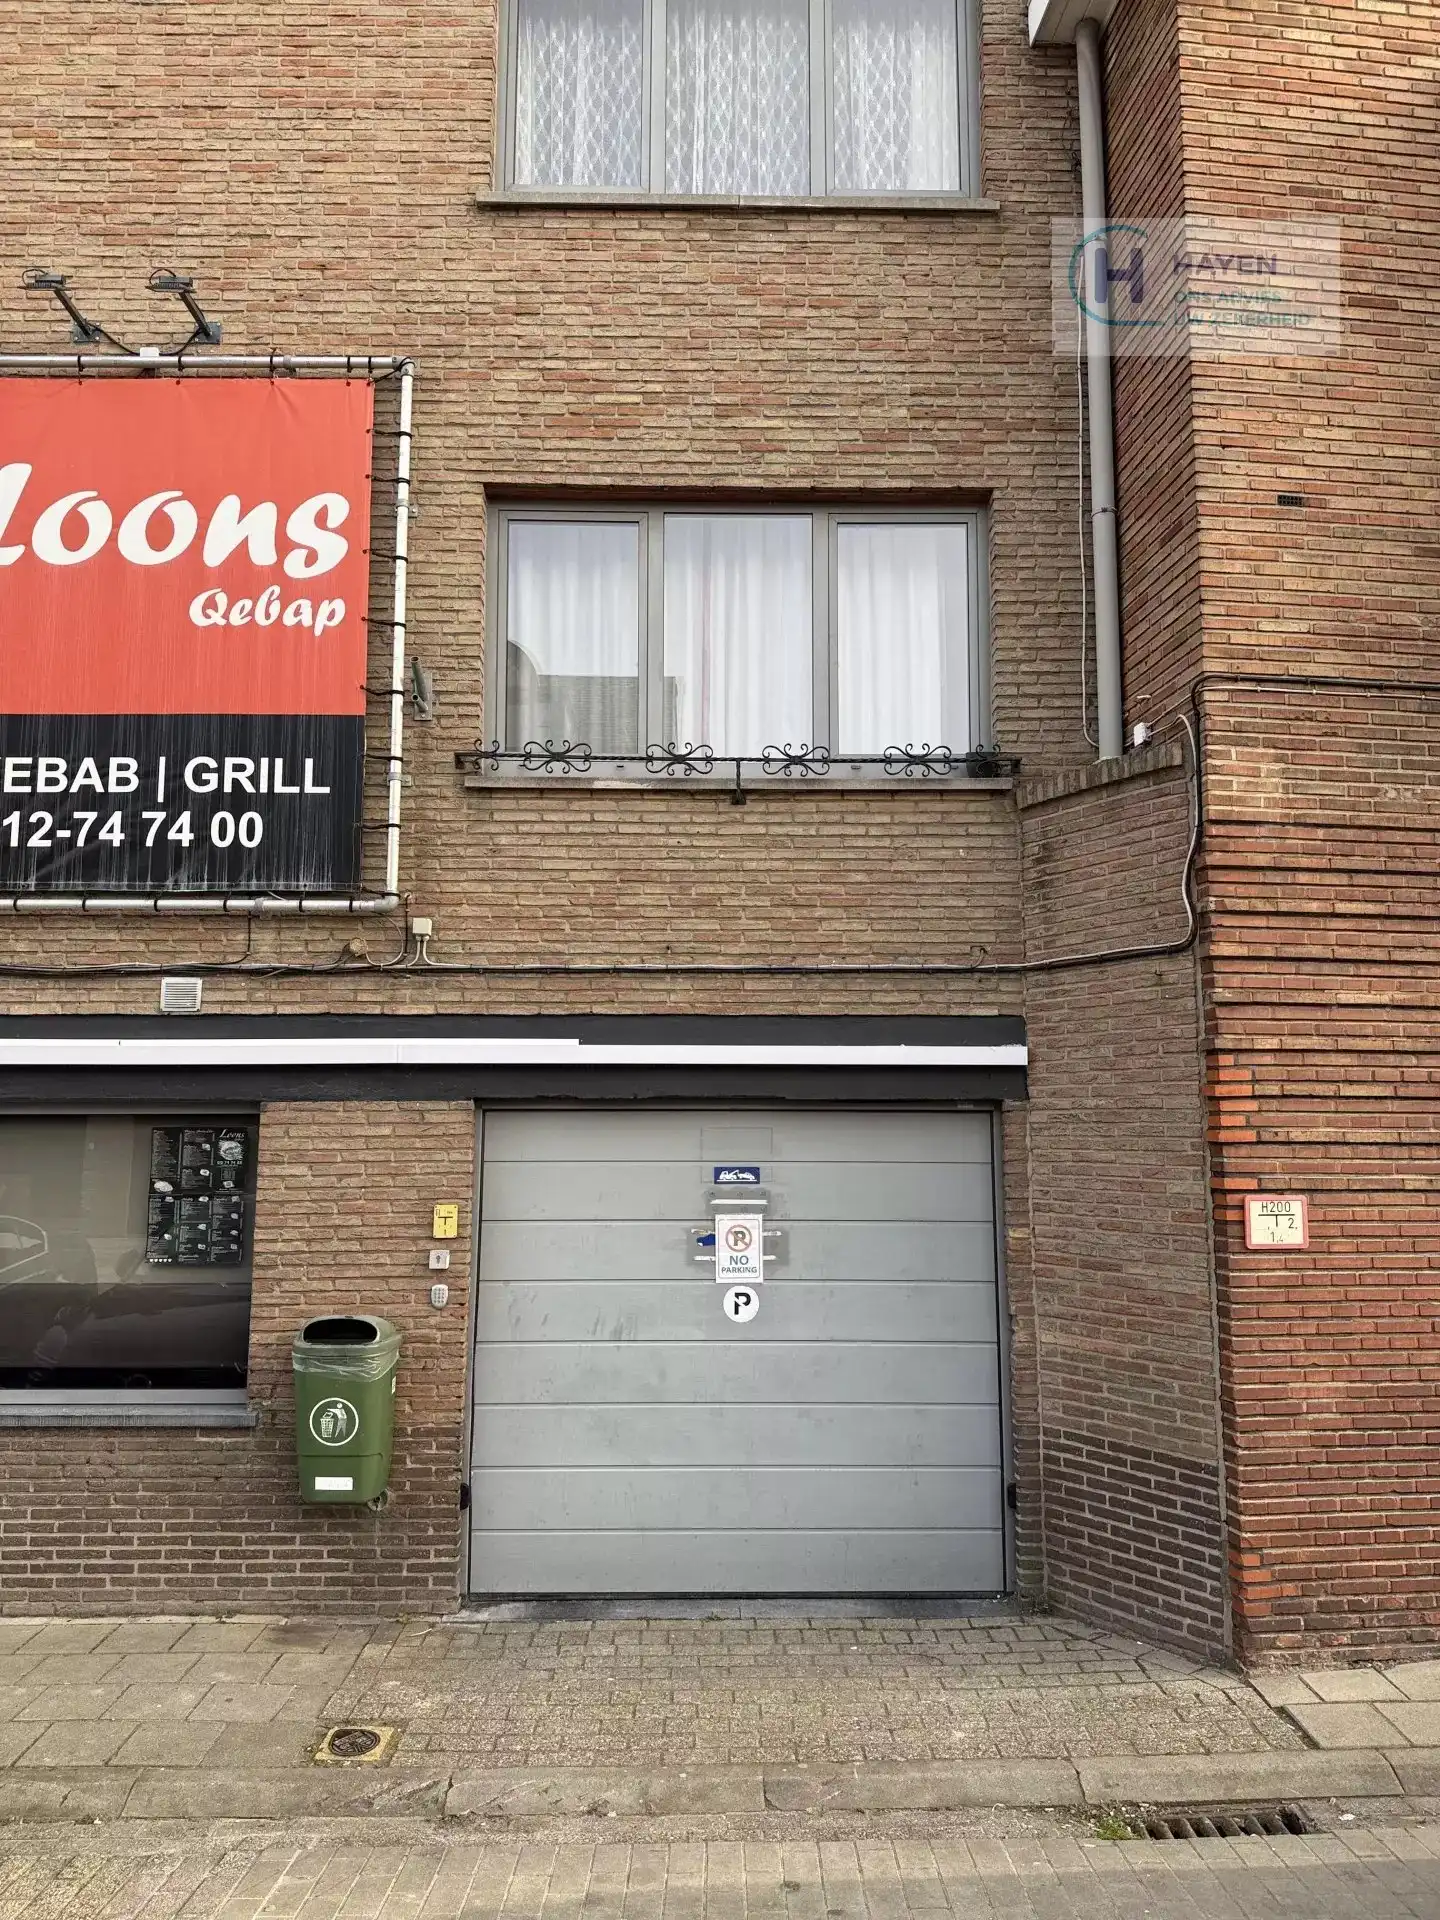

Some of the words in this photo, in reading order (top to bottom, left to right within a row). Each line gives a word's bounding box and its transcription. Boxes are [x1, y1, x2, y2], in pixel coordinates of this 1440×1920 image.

[188, 585, 346, 637] Qebap
[0, 756, 140, 793] EBAB
[183, 755, 331, 794] GRILL
[141, 811, 195, 848] 74
[210, 811, 264, 848] 00
[1261, 1201, 1291, 1213] H200
[721, 1266, 758, 1274] PARKING
[729, 1255, 749, 1266] NO
